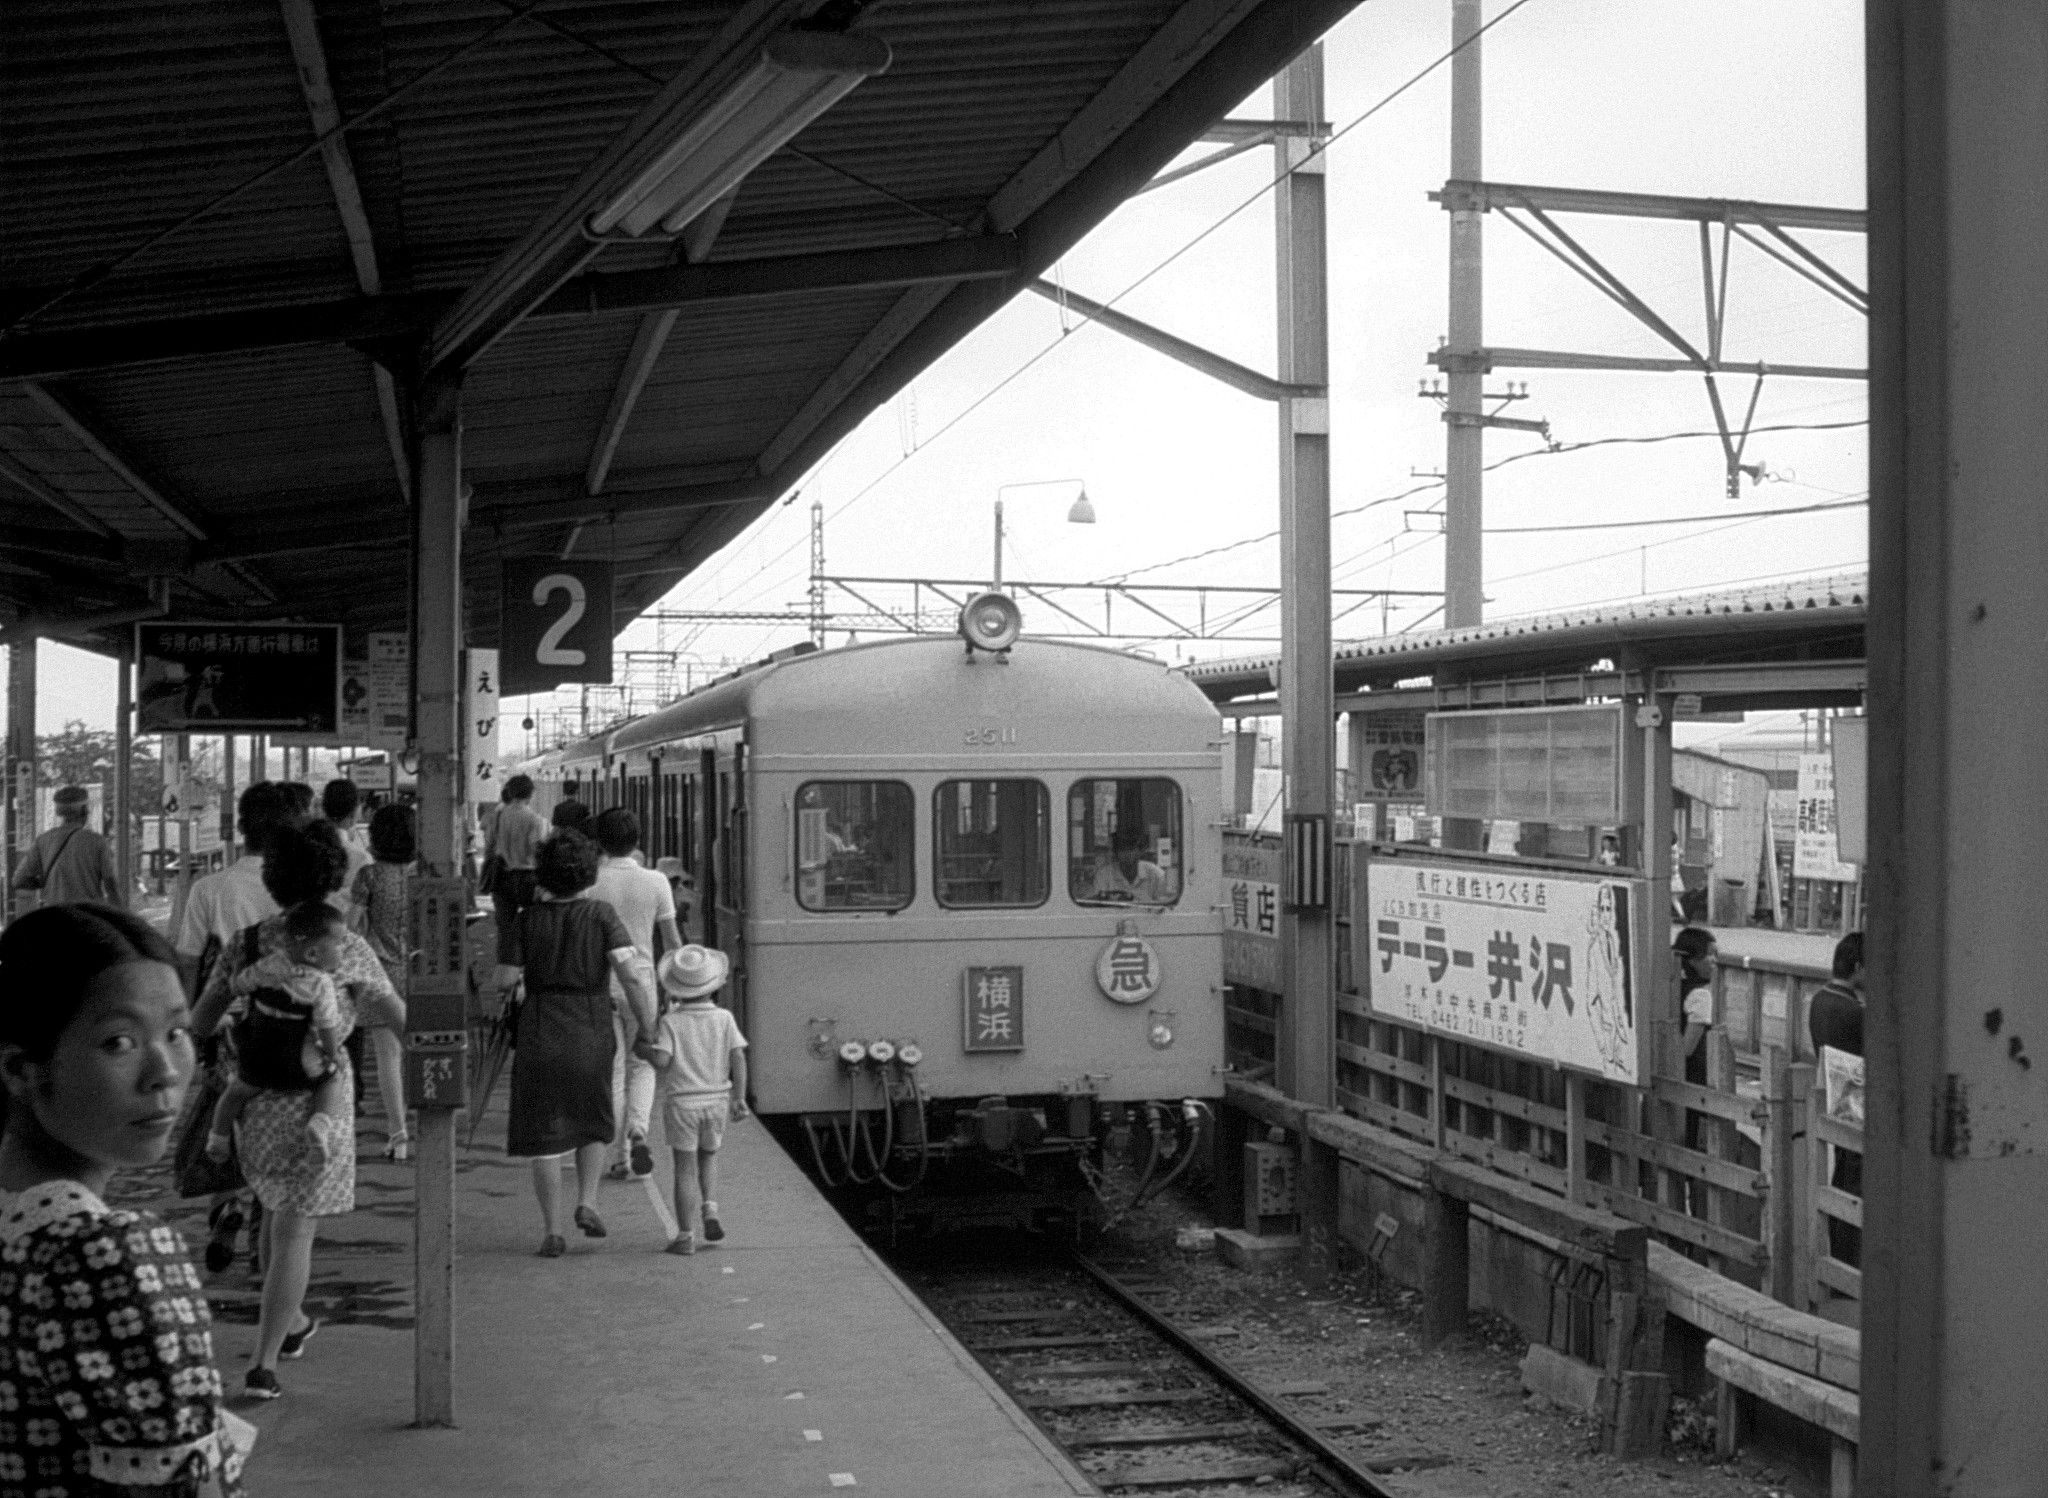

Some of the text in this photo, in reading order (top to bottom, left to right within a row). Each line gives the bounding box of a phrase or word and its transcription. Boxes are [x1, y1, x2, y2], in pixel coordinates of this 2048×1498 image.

[533, 574, 586, 666] 2
[476, 670, 496, 780] えびな
[964, 727, 1016, 746] 2511
[1110, 940, 1152, 991] 急
[1377, 919, 1575, 1017] テーラー井沢
[977, 976, 1012, 1041] 横浜
